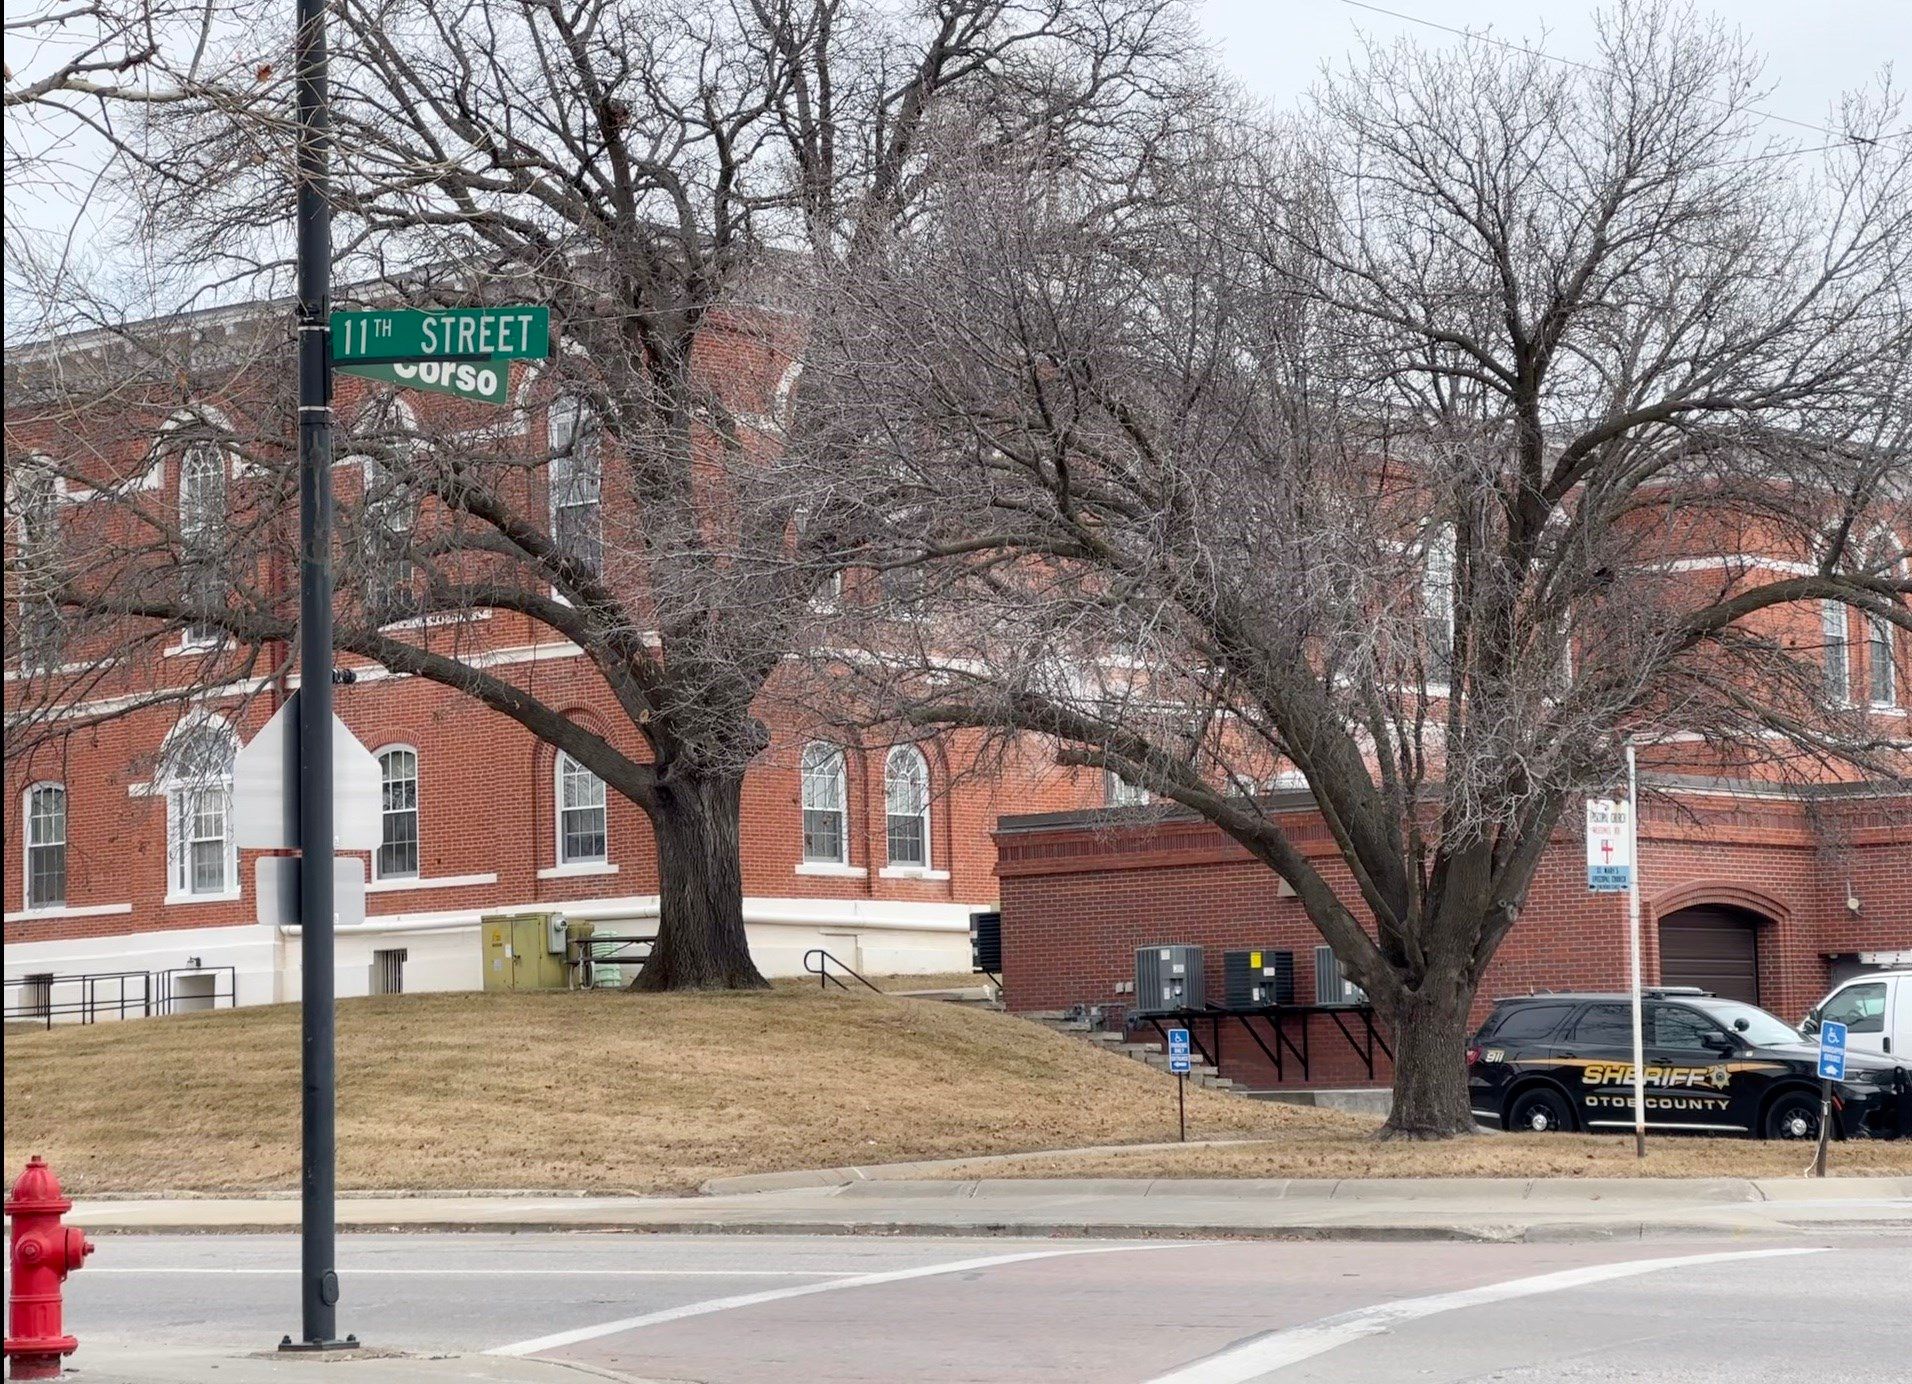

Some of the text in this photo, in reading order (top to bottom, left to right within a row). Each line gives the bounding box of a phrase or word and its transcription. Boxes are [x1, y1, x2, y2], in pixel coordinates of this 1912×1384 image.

[344, 315, 533, 355] 11TH STREET
[1485, 1050, 1505, 1063] 911
[1582, 1064, 1709, 1087] SHERIFF
[1645, 1097, 1731, 1111] COUNTY
